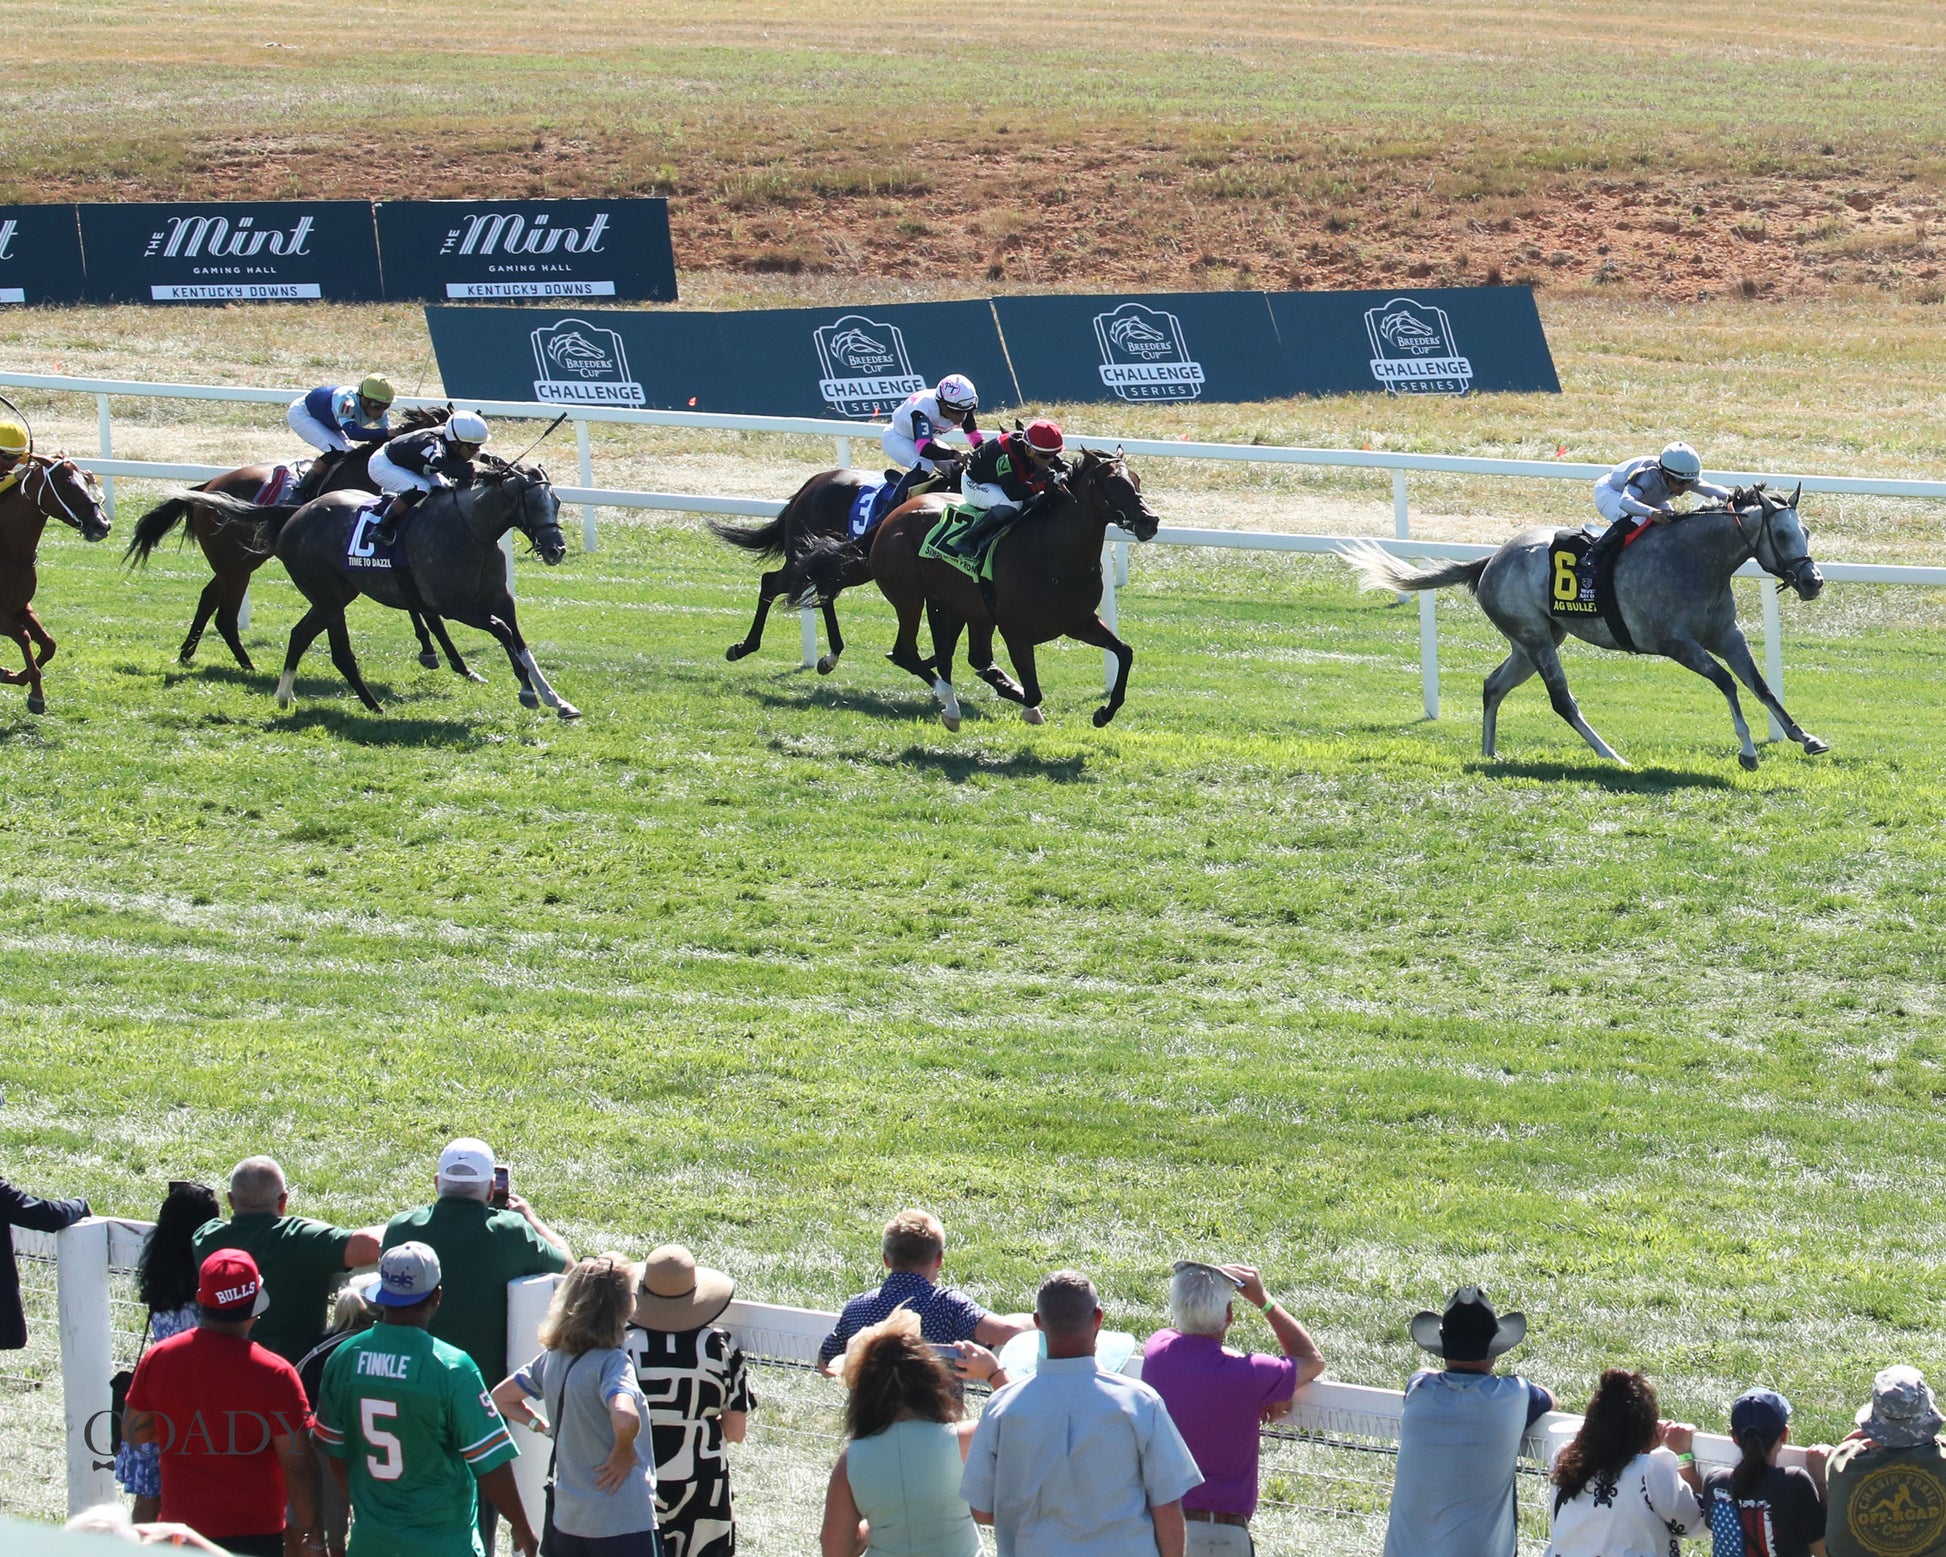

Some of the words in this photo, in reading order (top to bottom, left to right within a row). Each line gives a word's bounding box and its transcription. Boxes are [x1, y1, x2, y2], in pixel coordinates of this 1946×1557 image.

[144, 231, 164, 257] THE
[163, 216, 314, 257] Mint
[440, 229, 461, 255] THE
[459, 213, 610, 255] Mint
[193, 266, 241, 274] GAMING
[247, 266, 277, 274] HALL
[488, 264, 536, 272] GAMING
[541, 264, 572, 272] HALL
[172, 286, 242, 298] KENTUCKY
[250, 285, 298, 297] DOWNS
[467, 284, 538, 296] KENTUCKY
[545, 283, 593, 295] DOWNS
[1103, 366, 1201, 381] CHALLENGE
[1374, 361, 1469, 376] CHALLENGE
[538, 385, 642, 400] CHALLENGE
[824, 379, 923, 397] CHALLENGE
[1130, 386, 1186, 396] SERIES
[1400, 381, 1454, 391] SERIES
[920, 423, 930, 436] 3
[852, 492, 877, 534] 3
[929, 506, 975, 558] 12
[348, 557, 363, 567] TIME
[363, 558, 371, 567] TO
[1554, 550, 1577, 600] 6
[1553, 600, 1566, 611] AG
[215, 1281, 256, 1304] BULLS
[357, 1351, 411, 1380] FINKLE
[478, 1390, 498, 1418] 5
[360, 1397, 405, 1481] 5
